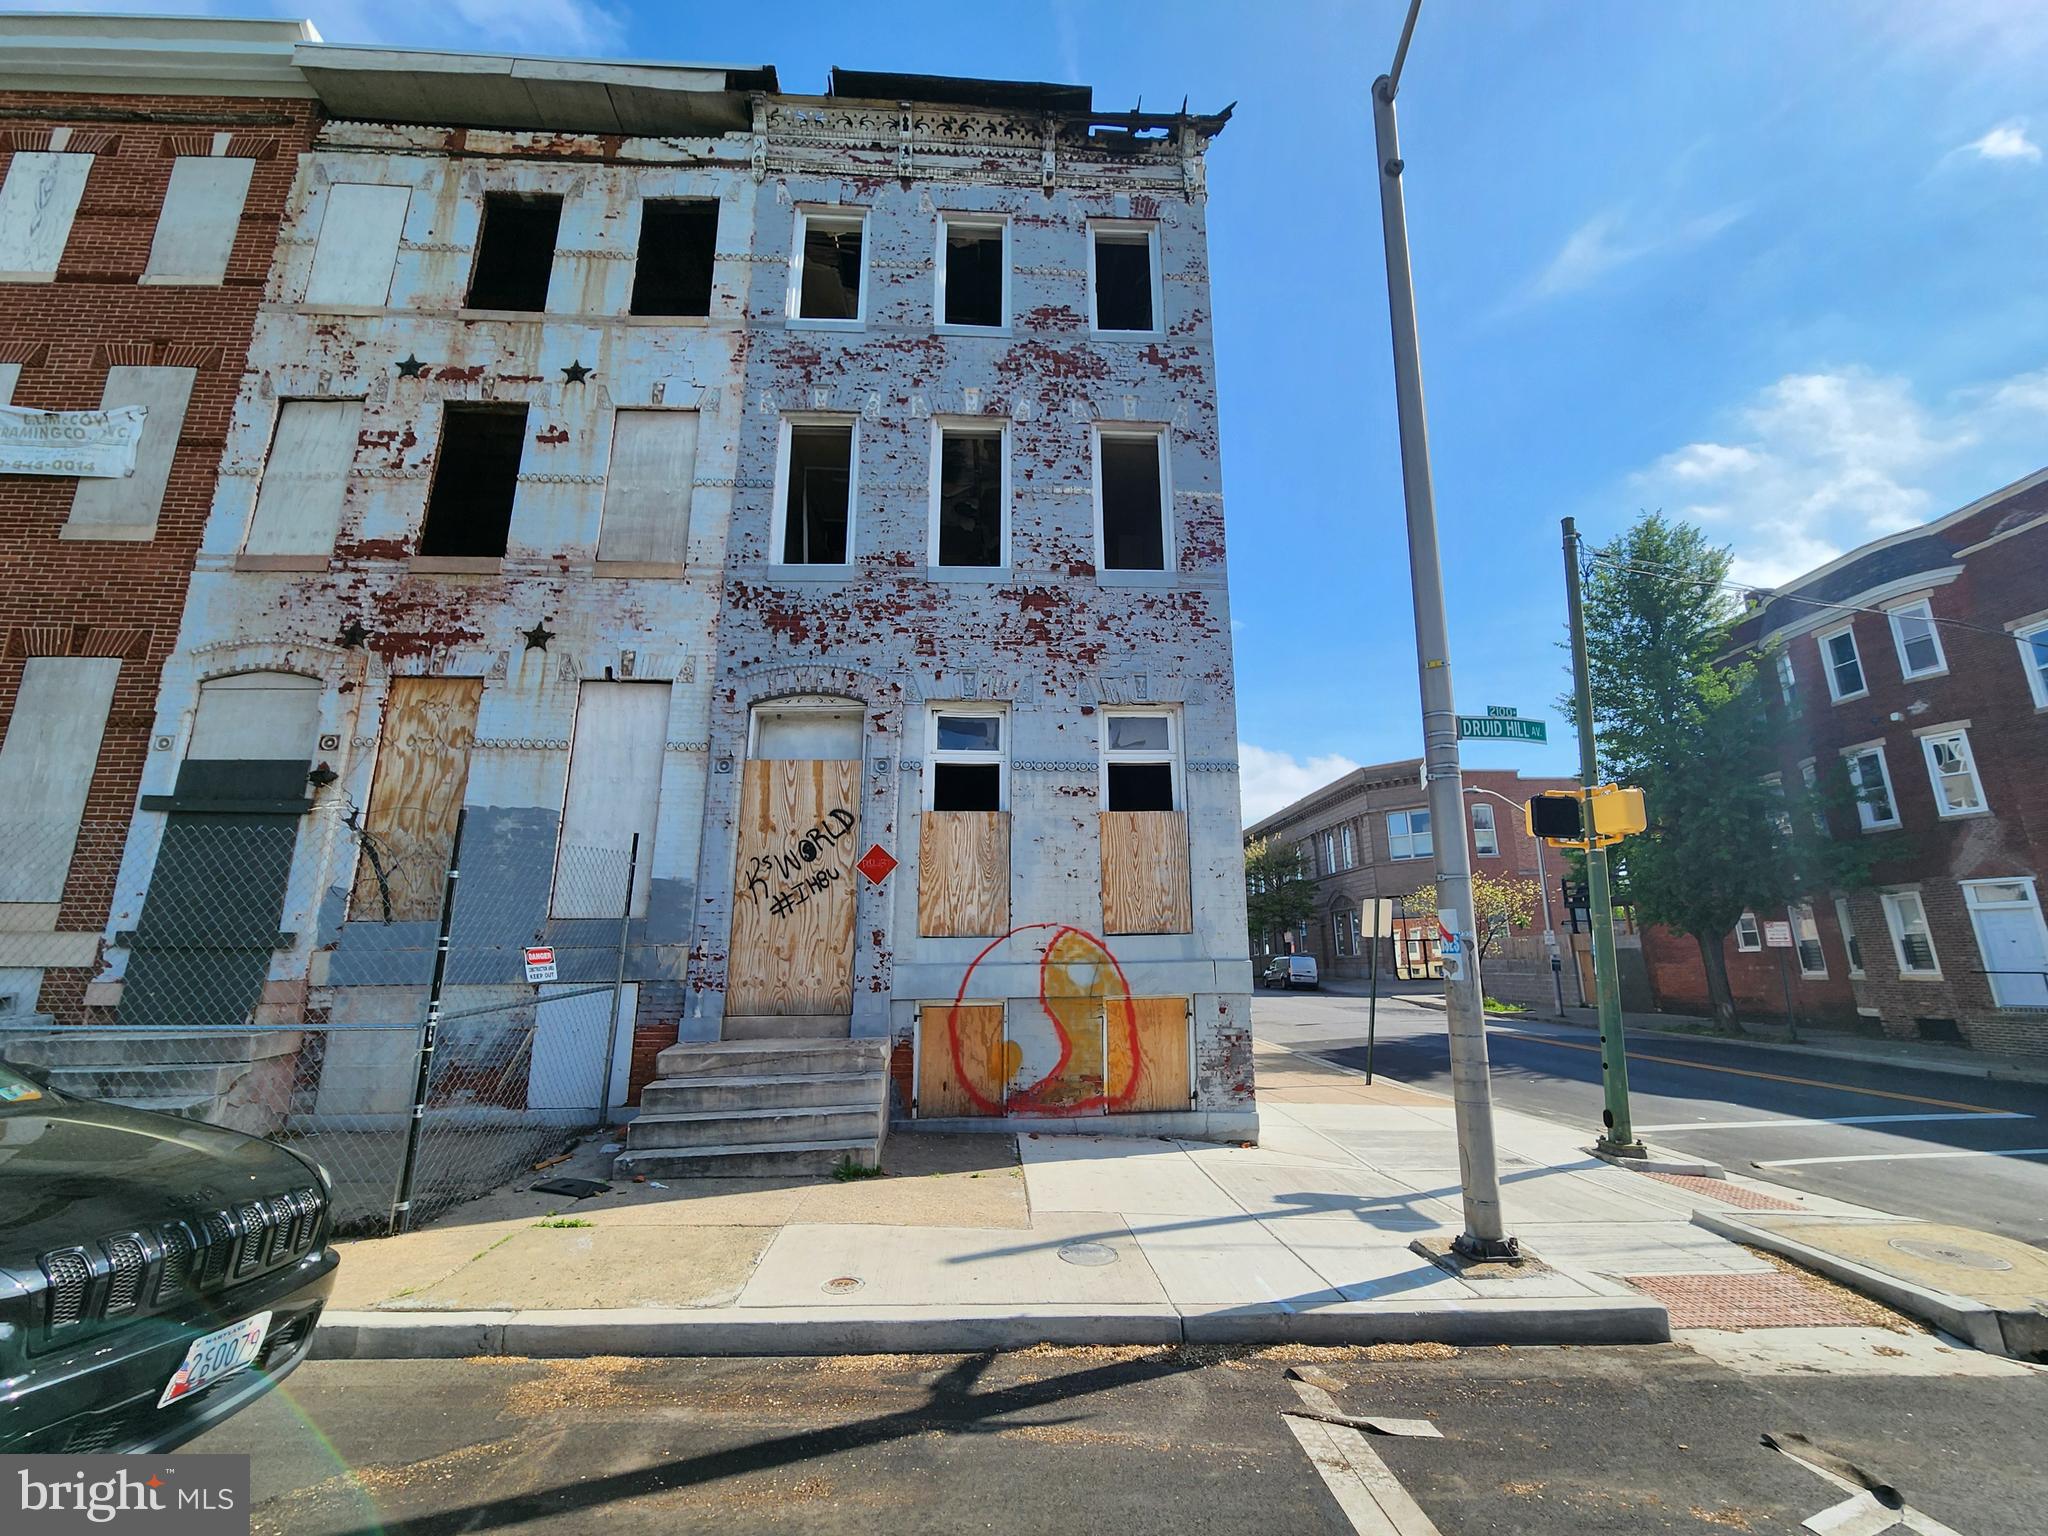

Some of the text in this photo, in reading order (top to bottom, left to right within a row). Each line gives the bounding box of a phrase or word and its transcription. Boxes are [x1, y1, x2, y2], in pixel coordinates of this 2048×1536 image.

[0, 426, 62, 439] RAMING
[1463, 720, 1502, 736] DRUID
[1506, 721, 1530, 737] HILL
[528, 952, 552, 960] DANGER
